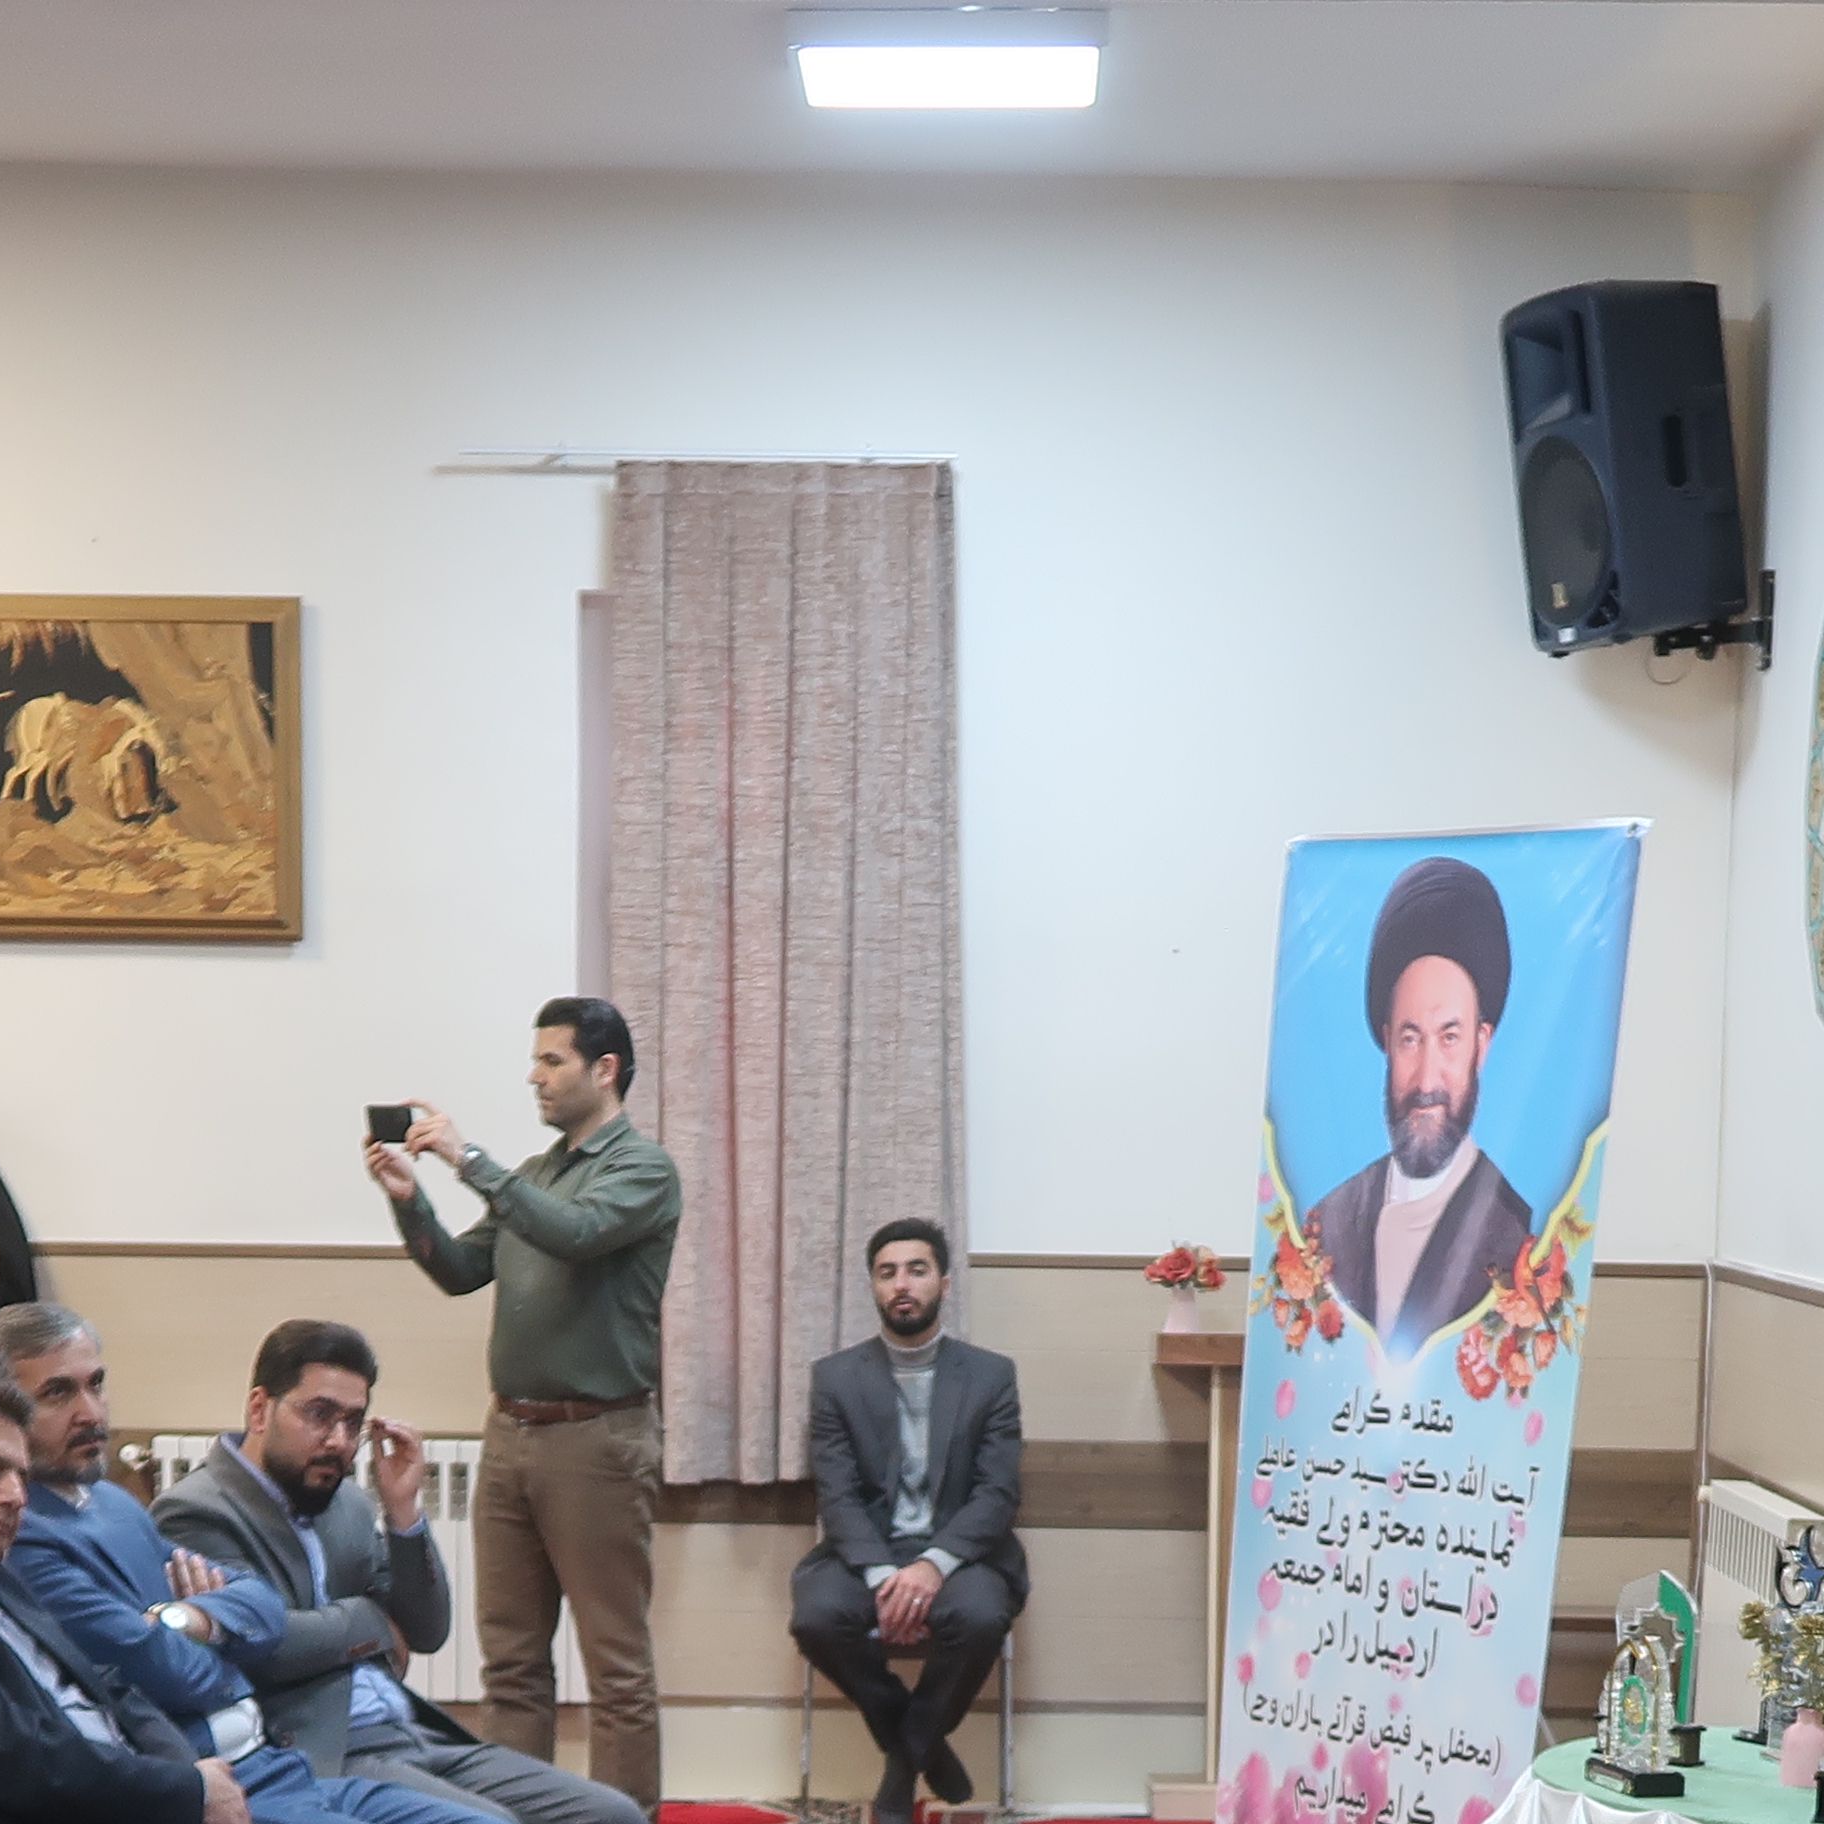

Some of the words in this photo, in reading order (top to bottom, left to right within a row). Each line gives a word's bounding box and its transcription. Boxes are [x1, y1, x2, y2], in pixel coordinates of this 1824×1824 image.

[1330, 1384, 1391, 1433] گرامی
[1399, 1398, 1455, 1435] مقدم
[1302, 1455, 1346, 1482] حسن
[1351, 1455, 1387, 1490] سید
[1393, 1459, 1450, 1494] دکتر
[1456, 1454, 1487, 1500] الله
[1265, 1489, 1310, 1537] فقیه
[1491, 1465, 1541, 1517] آیت
[1316, 1496, 1350, 1548] ولی
[1358, 1507, 1426, 1550] محترم
[1435, 1520, 1515, 1574] نماینده
[1269, 1560, 1326, 1594] جمعه
[1310, 1618, 1334, 1656] در
[1339, 1611, 1359, 1662] را
[1363, 1620, 1439, 1677] اردبیل
[1281, 1689, 1324, 1738] باران
[1370, 1714, 1412, 1754] فیض
[1414, 1740, 1434, 1774] پر
